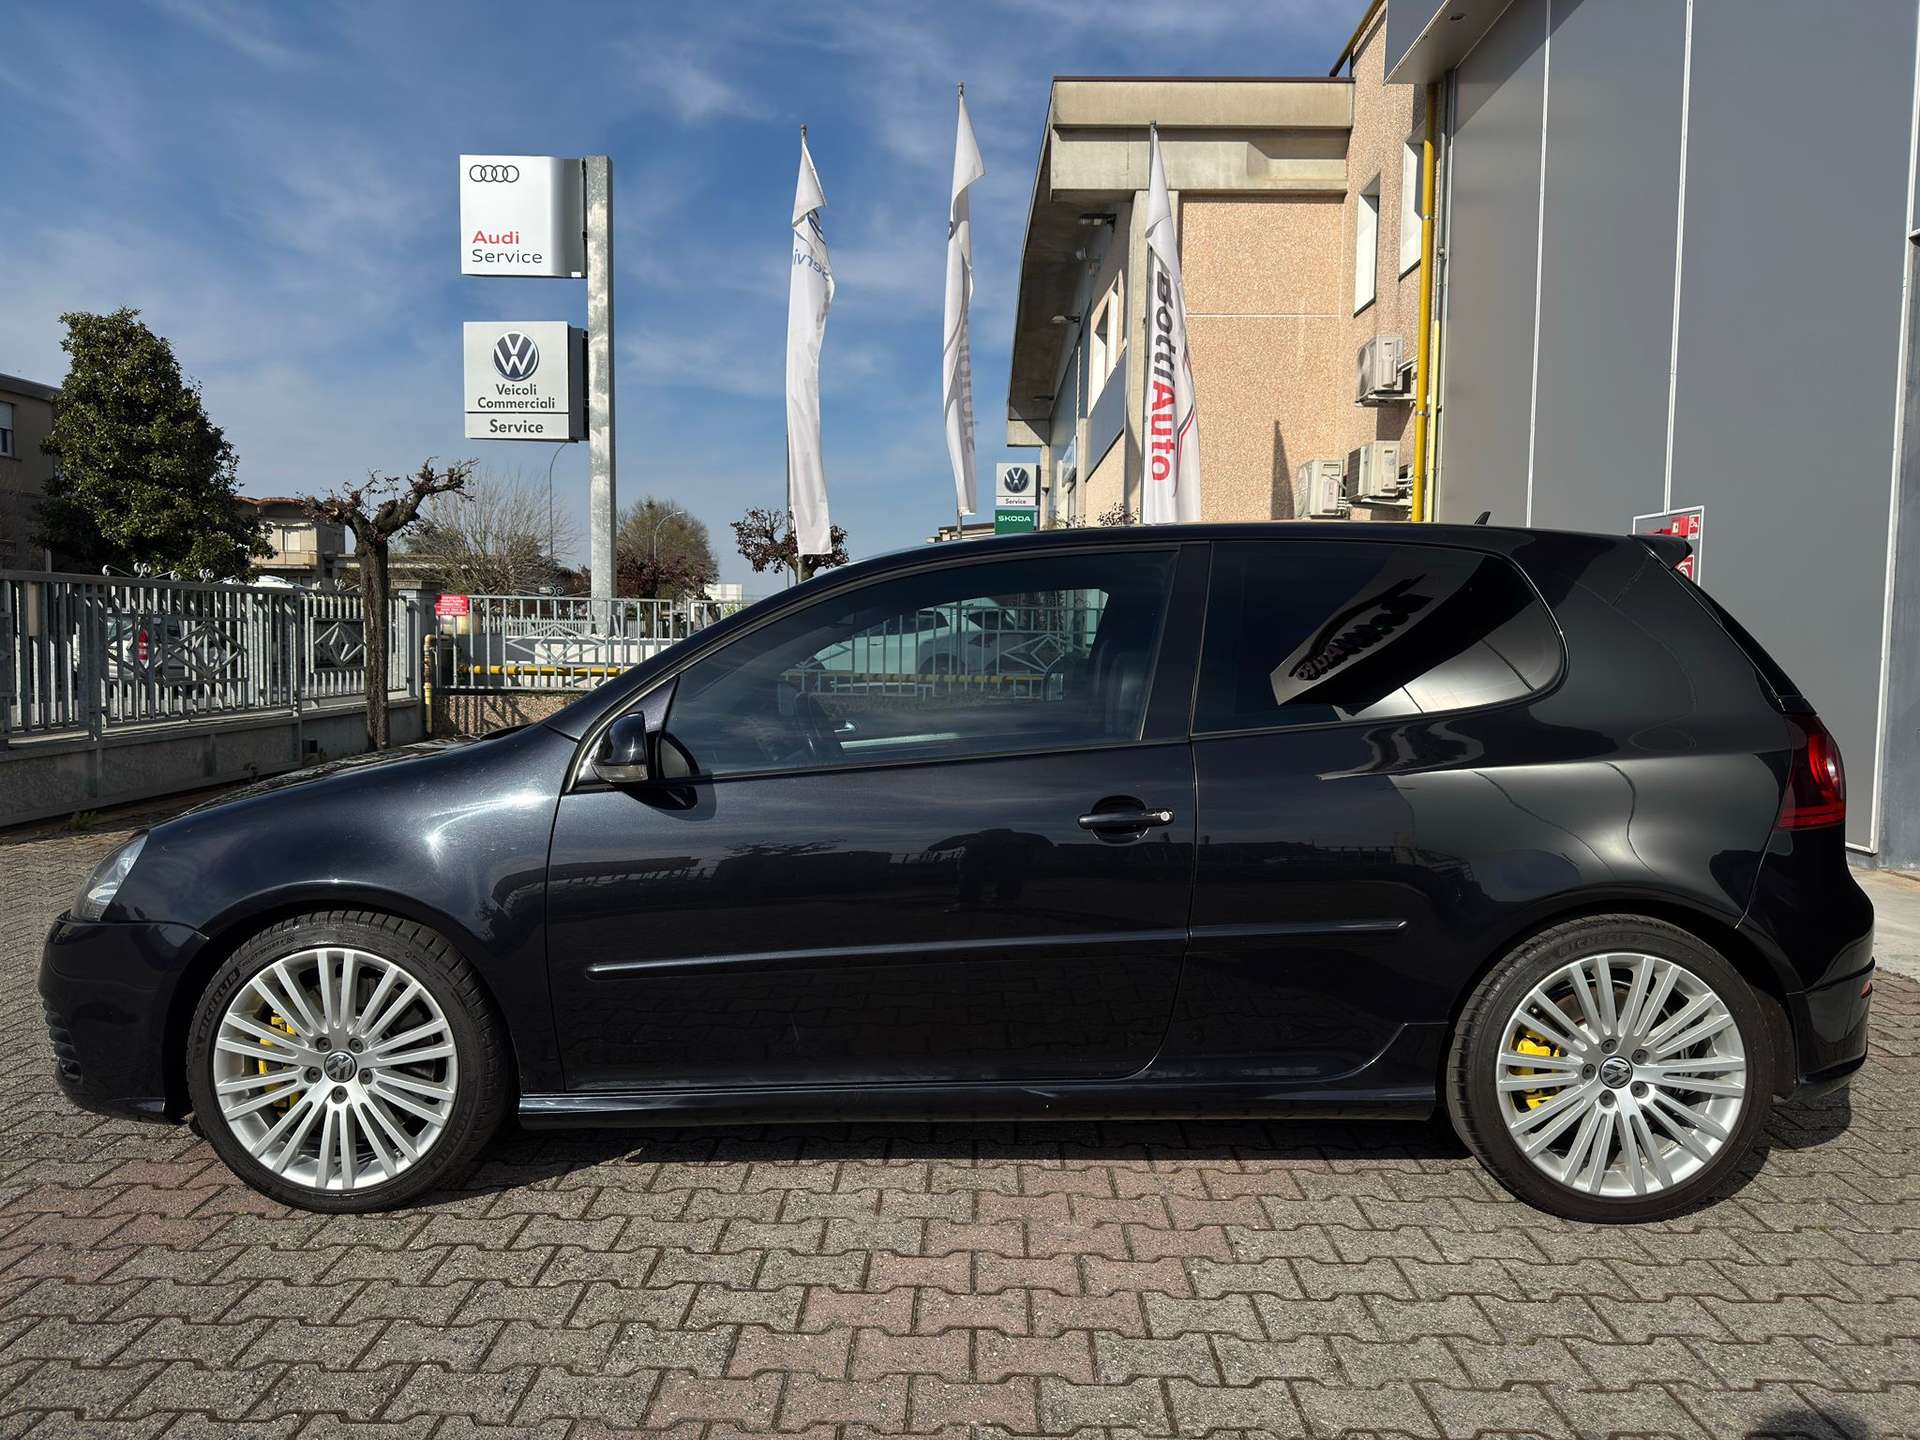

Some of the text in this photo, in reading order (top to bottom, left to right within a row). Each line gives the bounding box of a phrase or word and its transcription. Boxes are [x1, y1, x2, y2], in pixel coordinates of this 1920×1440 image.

[472, 230, 519, 245] Audi
[472, 249, 543, 264] Service
[495, 383, 537, 396] Veicoli
[477, 397, 555, 409] Commerciali
[489, 419, 544, 434] Service
